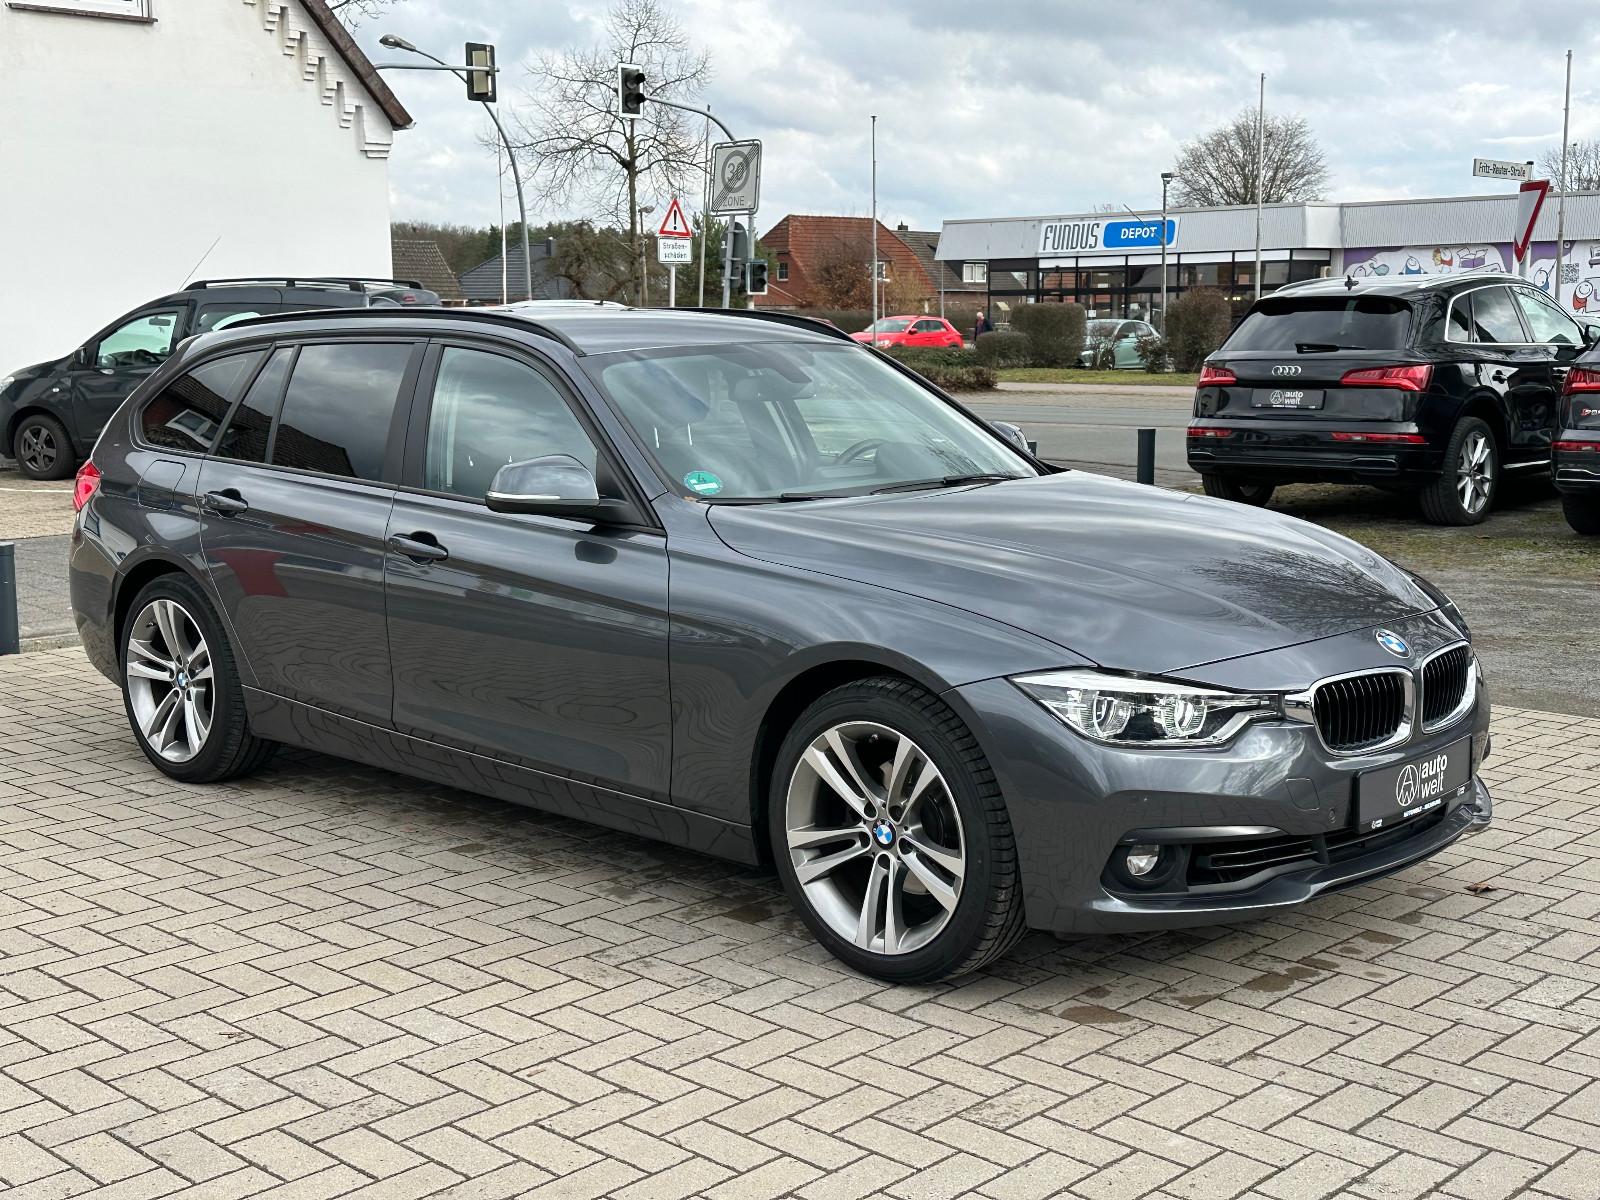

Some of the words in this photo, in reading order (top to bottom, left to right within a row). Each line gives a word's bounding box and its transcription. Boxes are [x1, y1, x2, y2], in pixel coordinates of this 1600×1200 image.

[1478, 161, 1526, 178] Fritz-Reuter-Straße
[1043, 222, 1100, 251] FUNDUS
[1120, 226, 1158, 239] DEPOT
[1421, 754, 1448, 779] auto
[1421, 771, 1444, 799] welt
